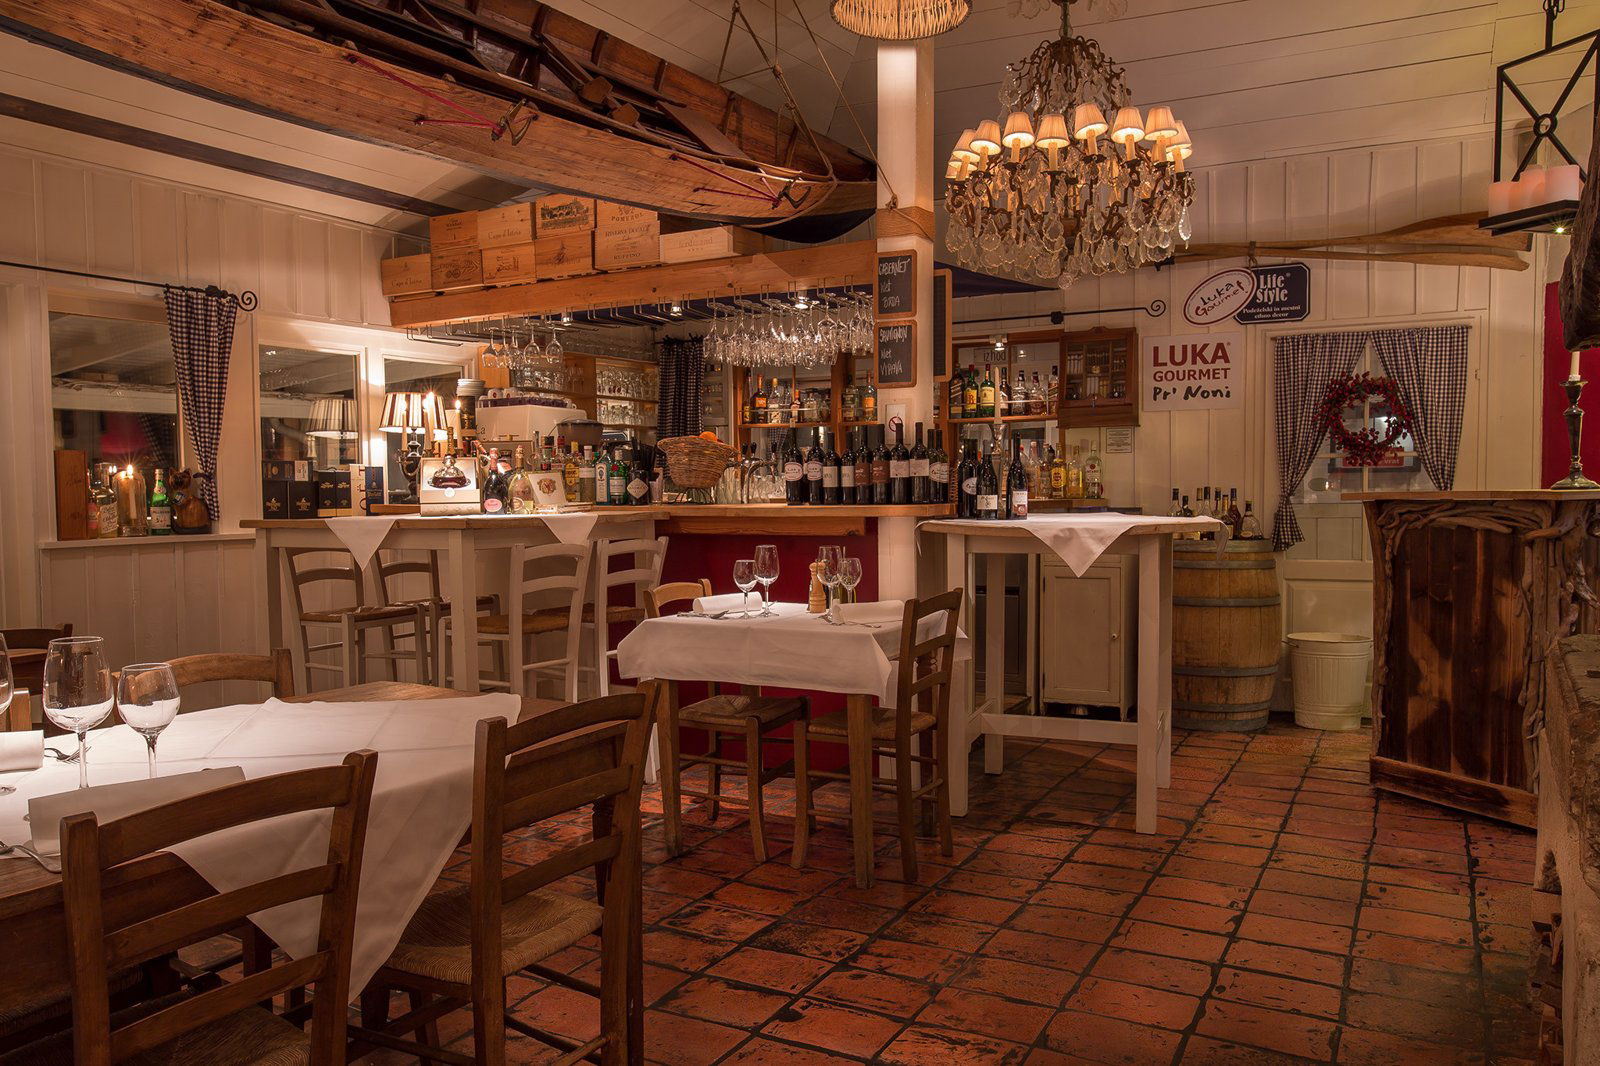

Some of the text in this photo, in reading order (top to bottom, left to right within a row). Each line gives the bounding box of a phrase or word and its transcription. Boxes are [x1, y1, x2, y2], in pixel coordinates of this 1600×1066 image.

[1259, 274, 1285, 289] Life
[1153, 342, 1230, 367] LUKA
[1153, 367, 1231, 382] GOURMET
[1183, 386, 1231, 401] Noni
